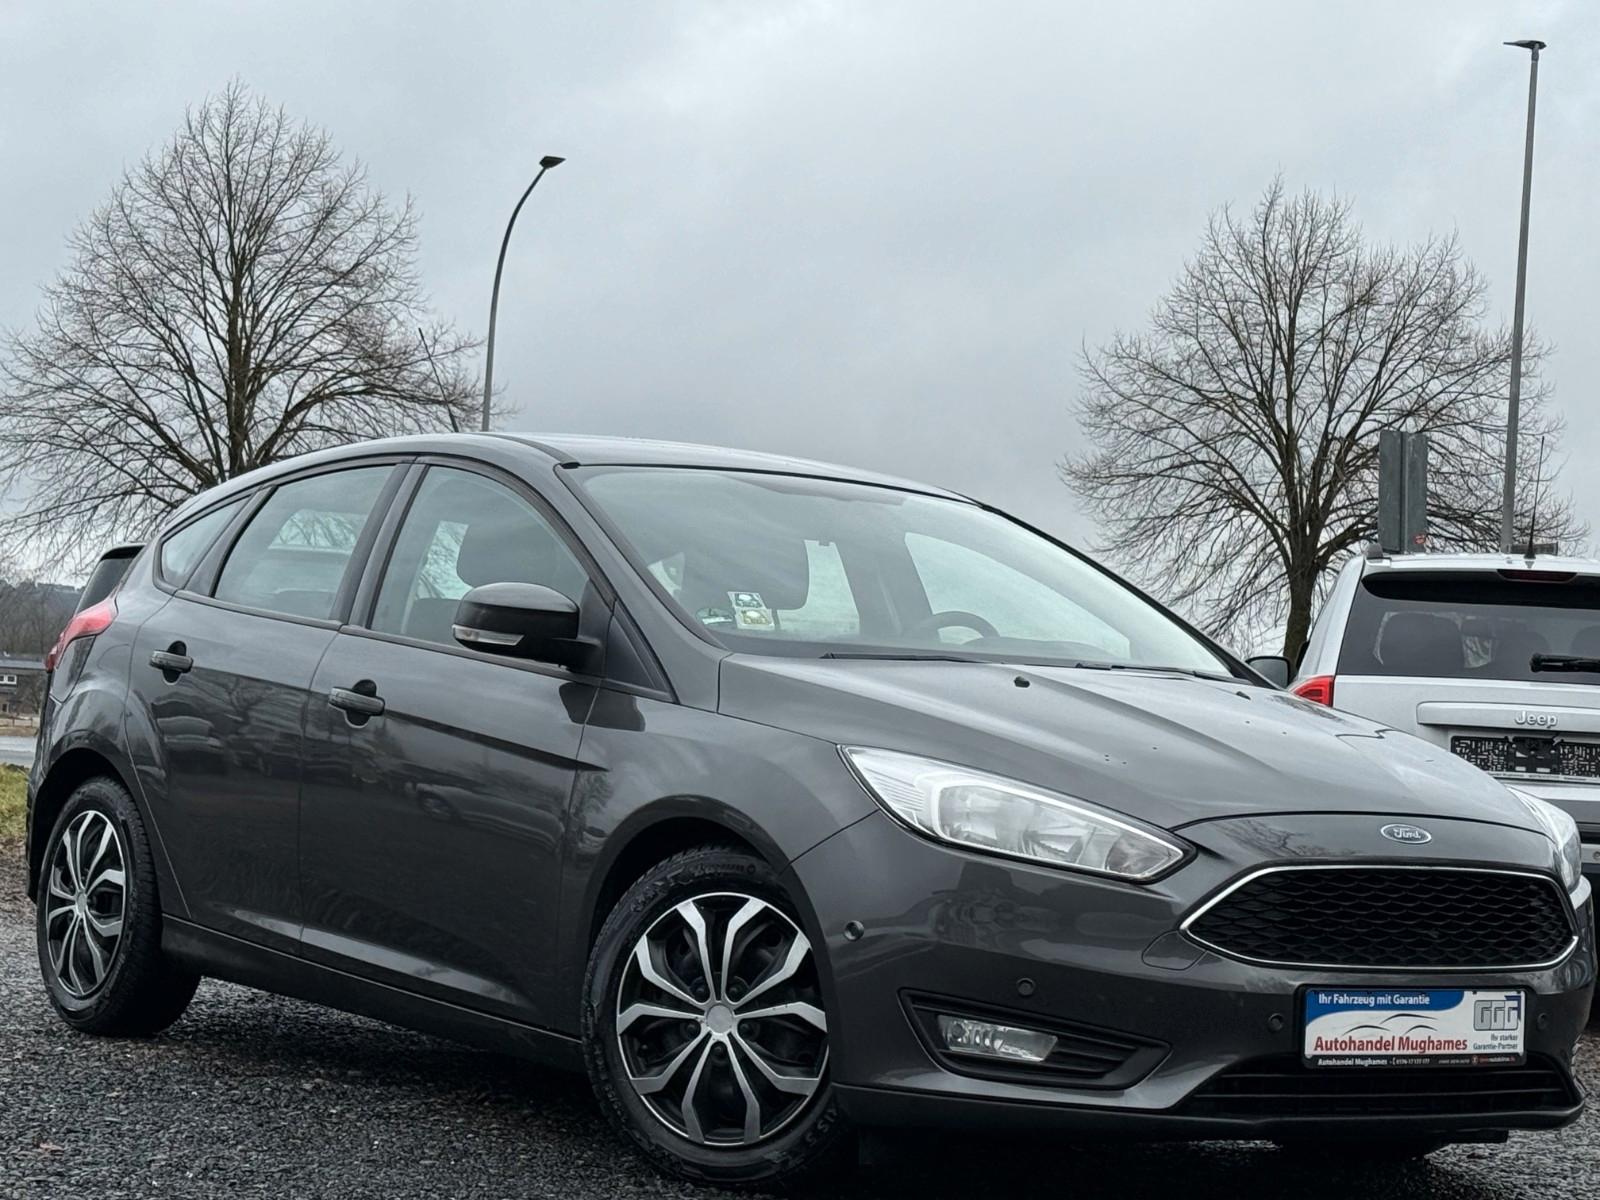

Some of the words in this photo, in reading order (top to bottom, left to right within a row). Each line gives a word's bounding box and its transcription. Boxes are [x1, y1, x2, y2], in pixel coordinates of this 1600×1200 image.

[1515, 710, 1558, 728] Jeep
[1392, 827, 1421, 839] Ford
[1318, 994, 1332, 1005] Ihr
[1333, 994, 1375, 1007] Fahrzeug
[1376, 994, 1392, 1005] mit
[1393, 994, 1430, 1005] Garantie
[1314, 1036, 1395, 1051] Autohandel
[1398, 1036, 1467, 1053] Mughames
[1318, 1058, 1354, 1066] Autohandel
